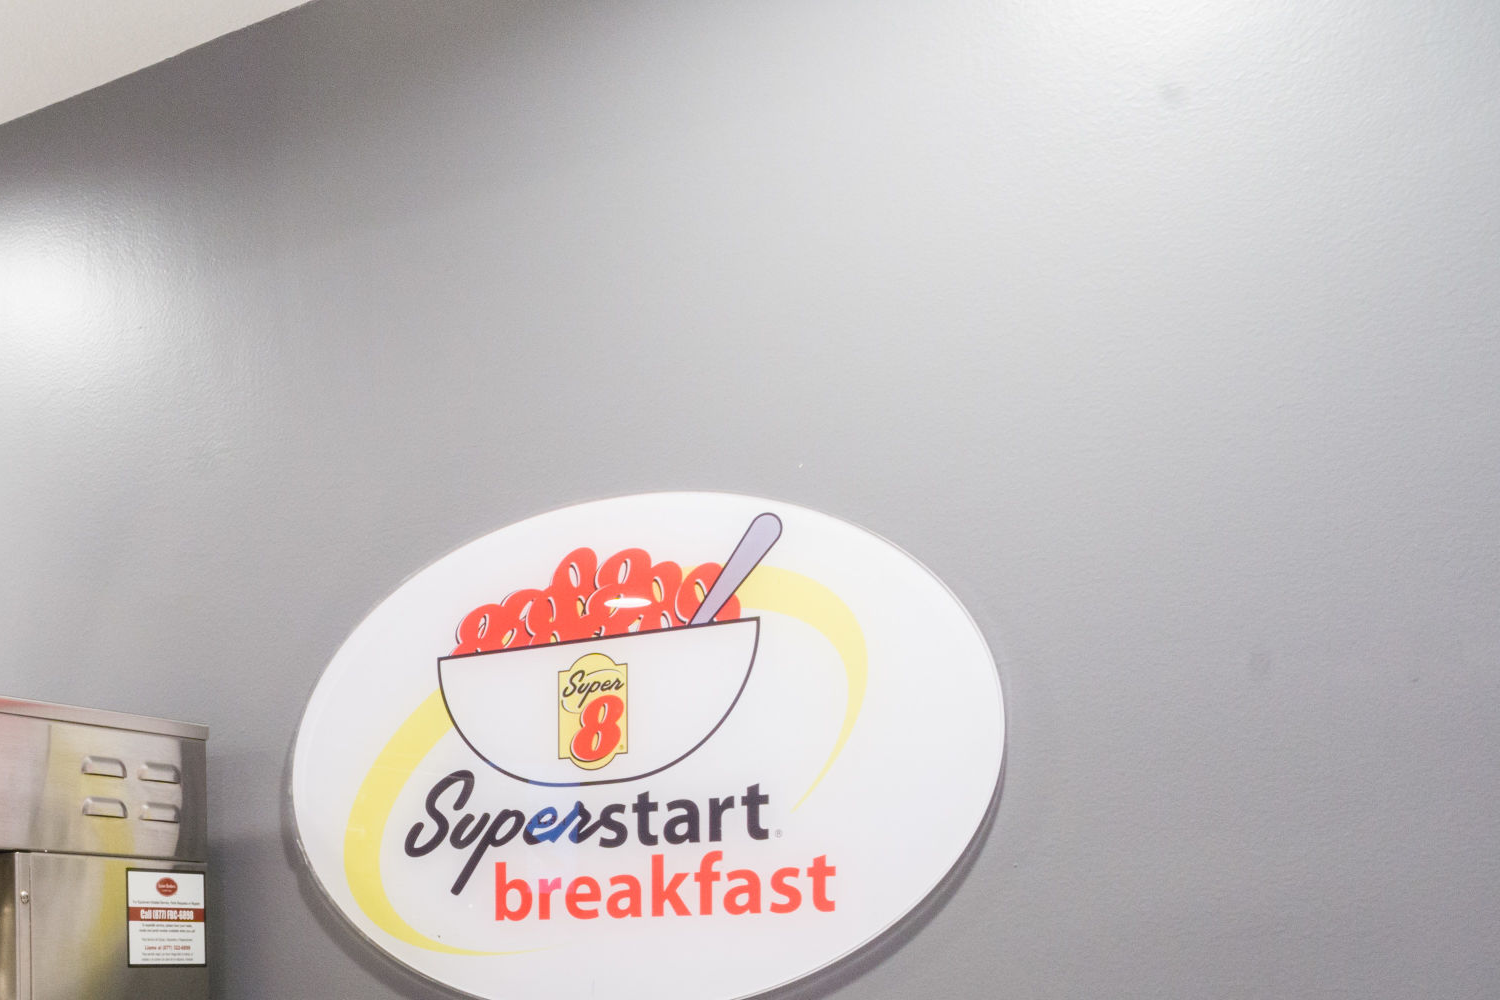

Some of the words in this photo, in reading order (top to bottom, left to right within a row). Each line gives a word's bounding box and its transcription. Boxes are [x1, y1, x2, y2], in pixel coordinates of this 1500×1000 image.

[562, 670, 624, 708] Super
[570, 694, 625, 762] 8
[495, 851, 837, 922] breakfast
